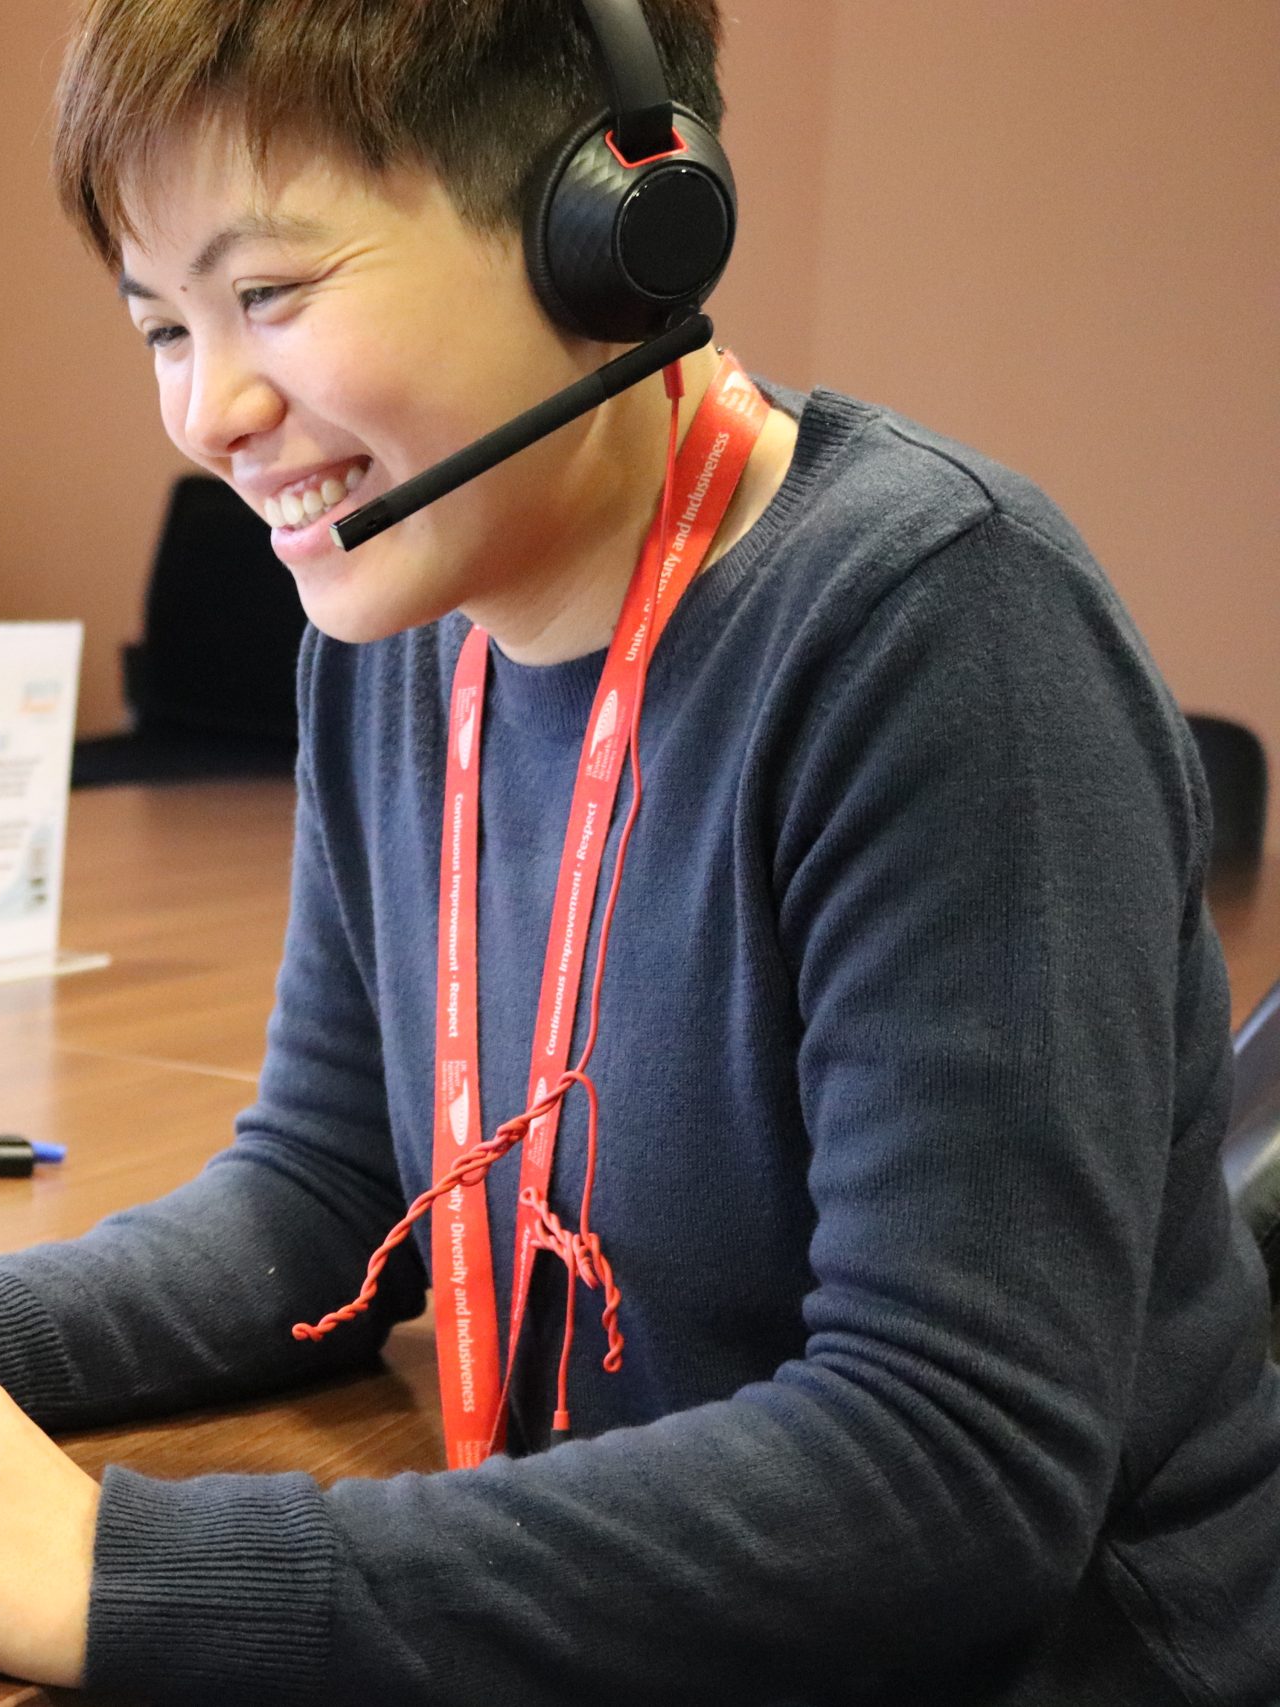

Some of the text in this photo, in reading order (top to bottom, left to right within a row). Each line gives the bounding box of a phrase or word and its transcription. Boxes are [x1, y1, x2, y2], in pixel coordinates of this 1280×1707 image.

[672, 522, 692, 551] and
[682, 432, 731, 521] Inclusiveness
[446, 793, 464, 1038] Continuous Improvement Respect
[545, 802, 598, 1056] Continuous Improvement Respect
[448, 1184, 476, 1412] nity Diversity and Inclusiveness
